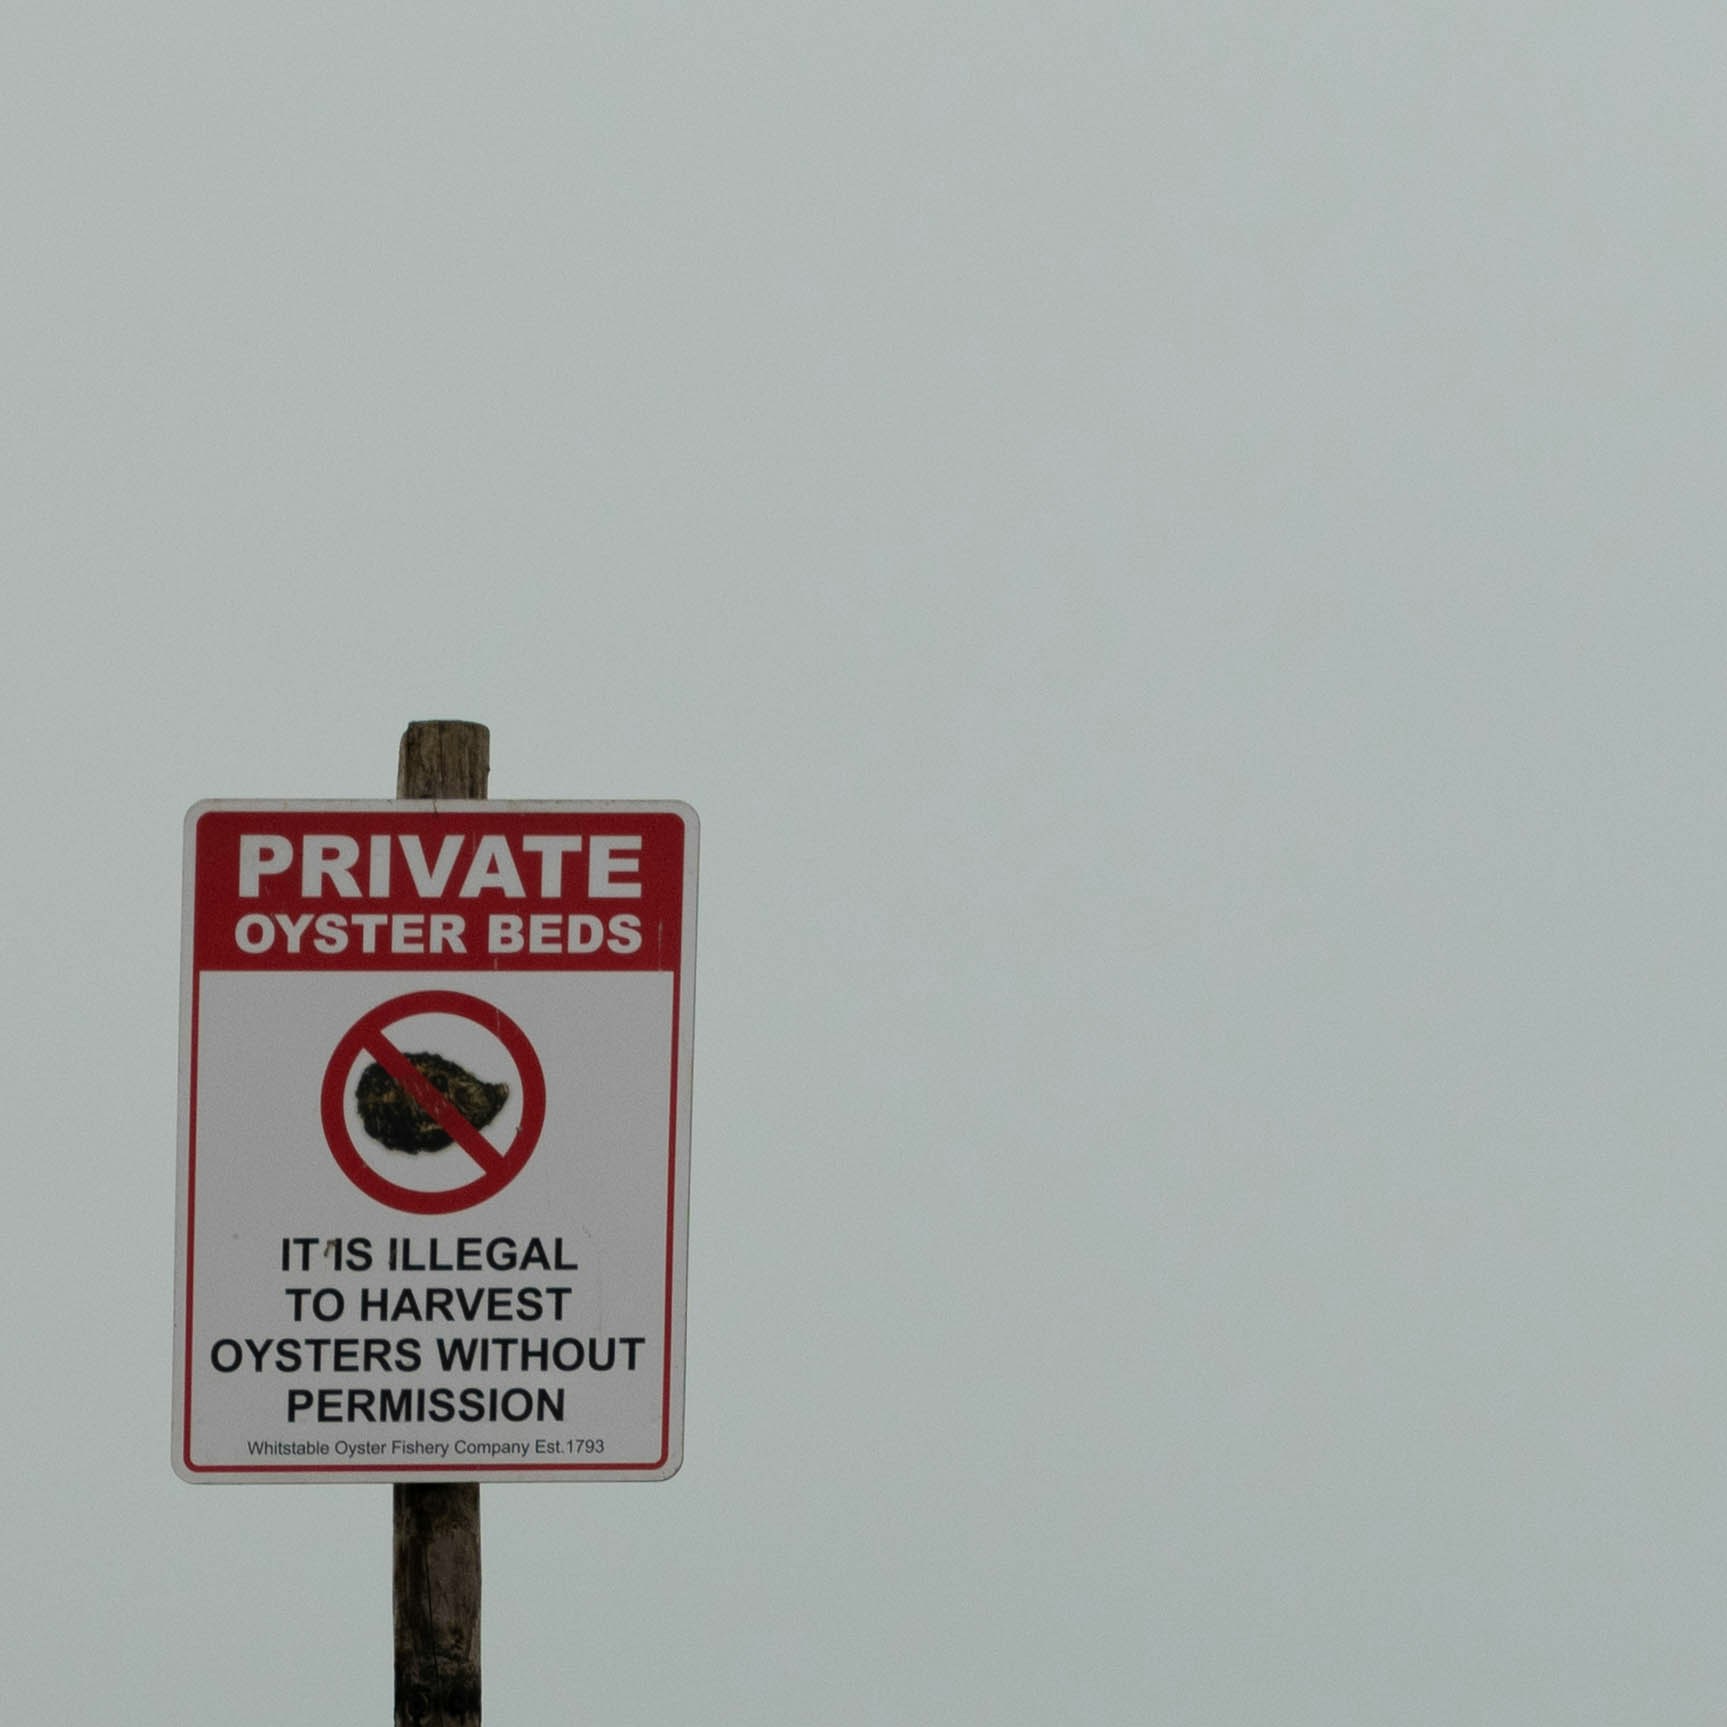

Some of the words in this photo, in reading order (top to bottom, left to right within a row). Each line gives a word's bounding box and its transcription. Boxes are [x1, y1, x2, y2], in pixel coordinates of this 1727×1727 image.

[239, 834, 642, 898] PRIVATE
[235, 913, 467, 954] OYSTER
[488, 914, 642, 954] BEDS
[281, 1237, 321, 1273] IT
[334, 1236, 374, 1273] IS
[388, 1236, 579, 1272] ILLEGAL
[285, 1287, 346, 1323] TO
[360, 1286, 573, 1323] HARVEST
[210, 1337, 422, 1374] OYSTERS
[436, 1336, 647, 1373] WITHOUT
[287, 1386, 566, 1424] PERMISSION
[247, 1440, 331, 1456] Whitstable
[334, 1440, 388, 1459] Oyster
[391, 1439, 450, 1459] Fishery
[453, 1439, 531, 1459] Company
